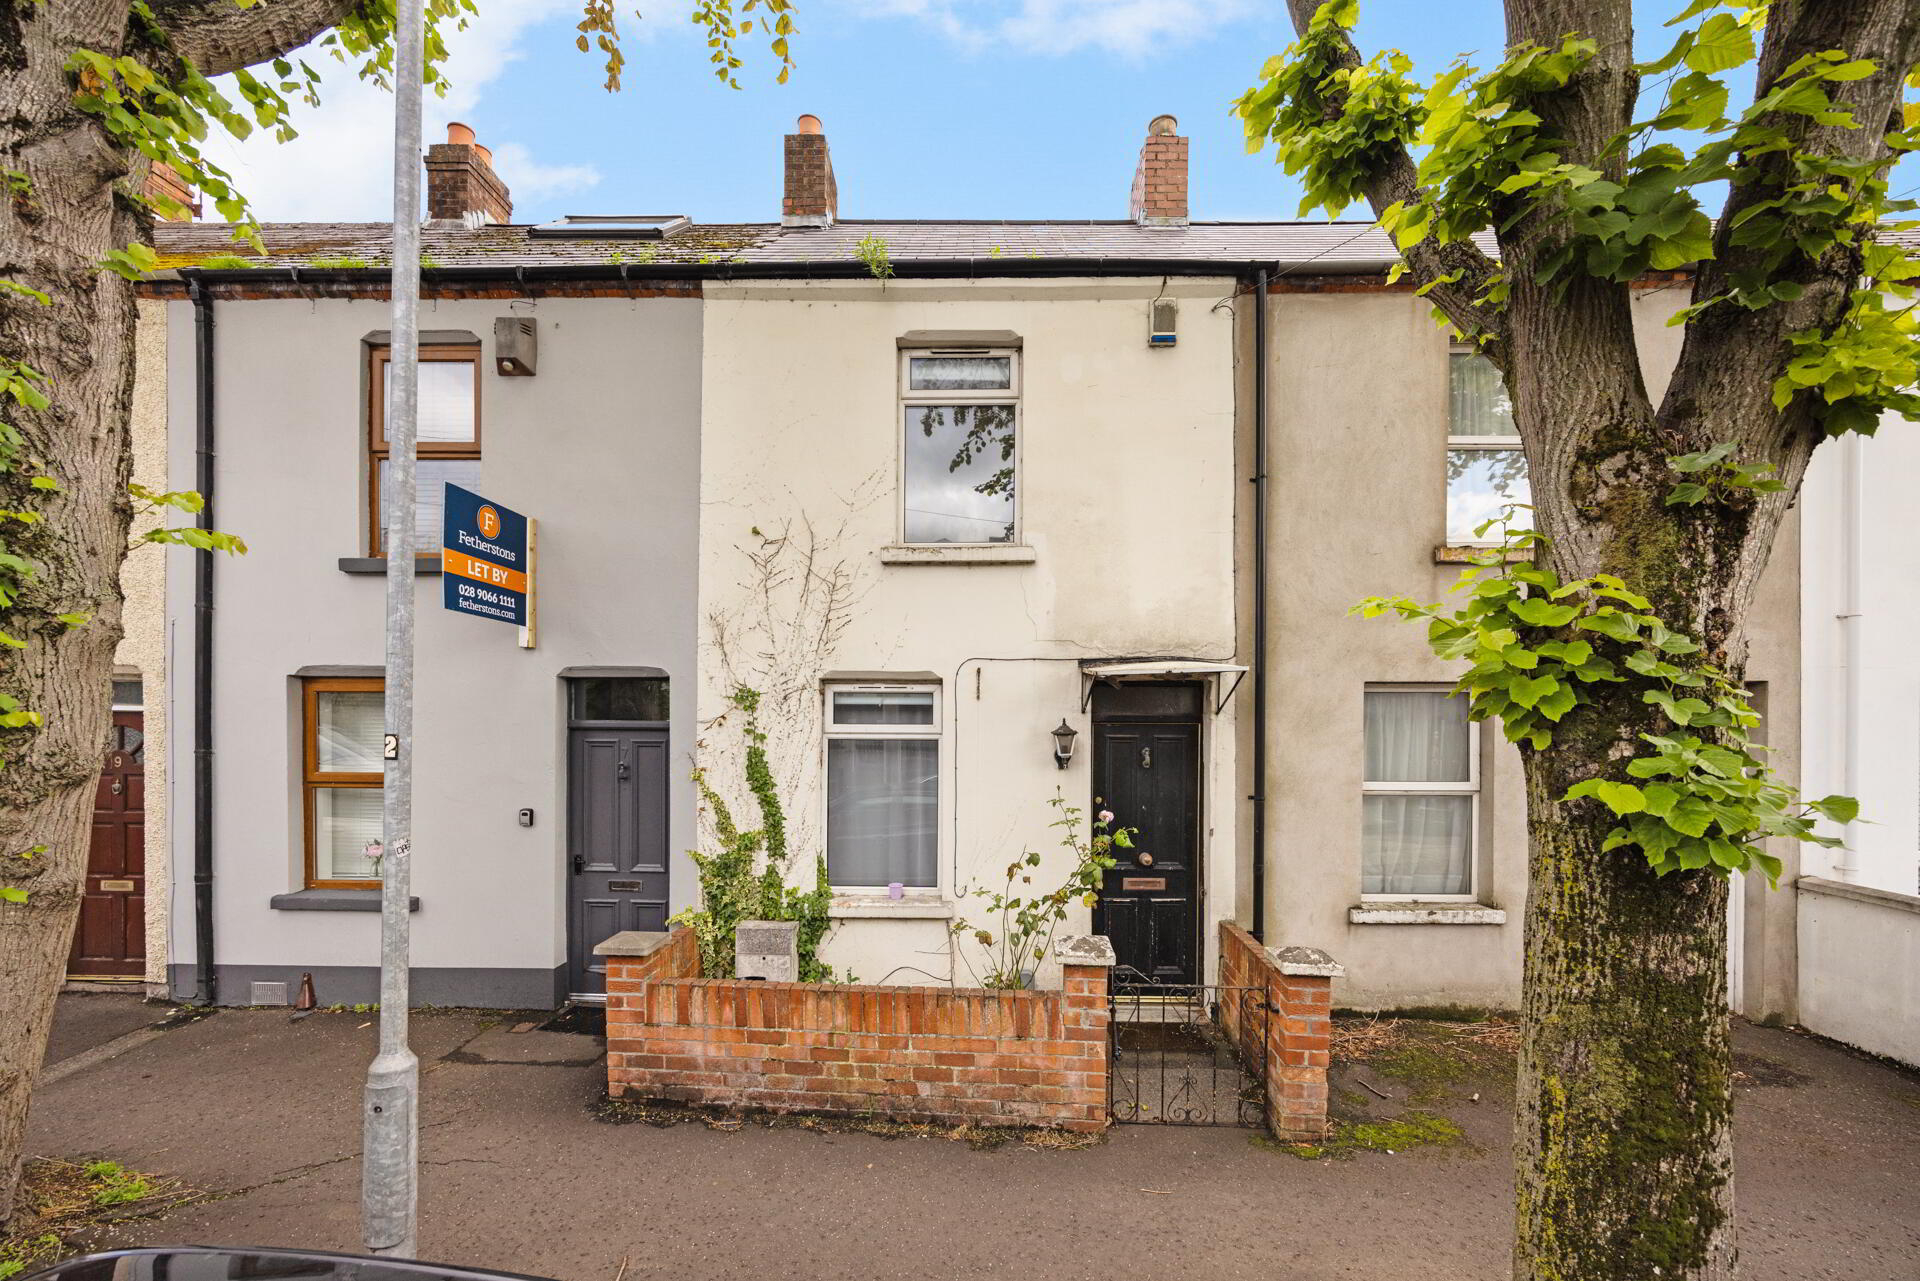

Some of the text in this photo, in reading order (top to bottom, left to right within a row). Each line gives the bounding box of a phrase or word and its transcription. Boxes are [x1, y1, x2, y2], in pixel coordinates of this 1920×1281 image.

[483, 512, 495, 531] F
[458, 530, 516, 561] Fetherstons
[467, 559, 508, 584] LET BY
[458, 584, 516, 608] 028 9066 1111
[458, 597, 516, 620] fetherstons.com
[384, 735, 397, 758] 2
